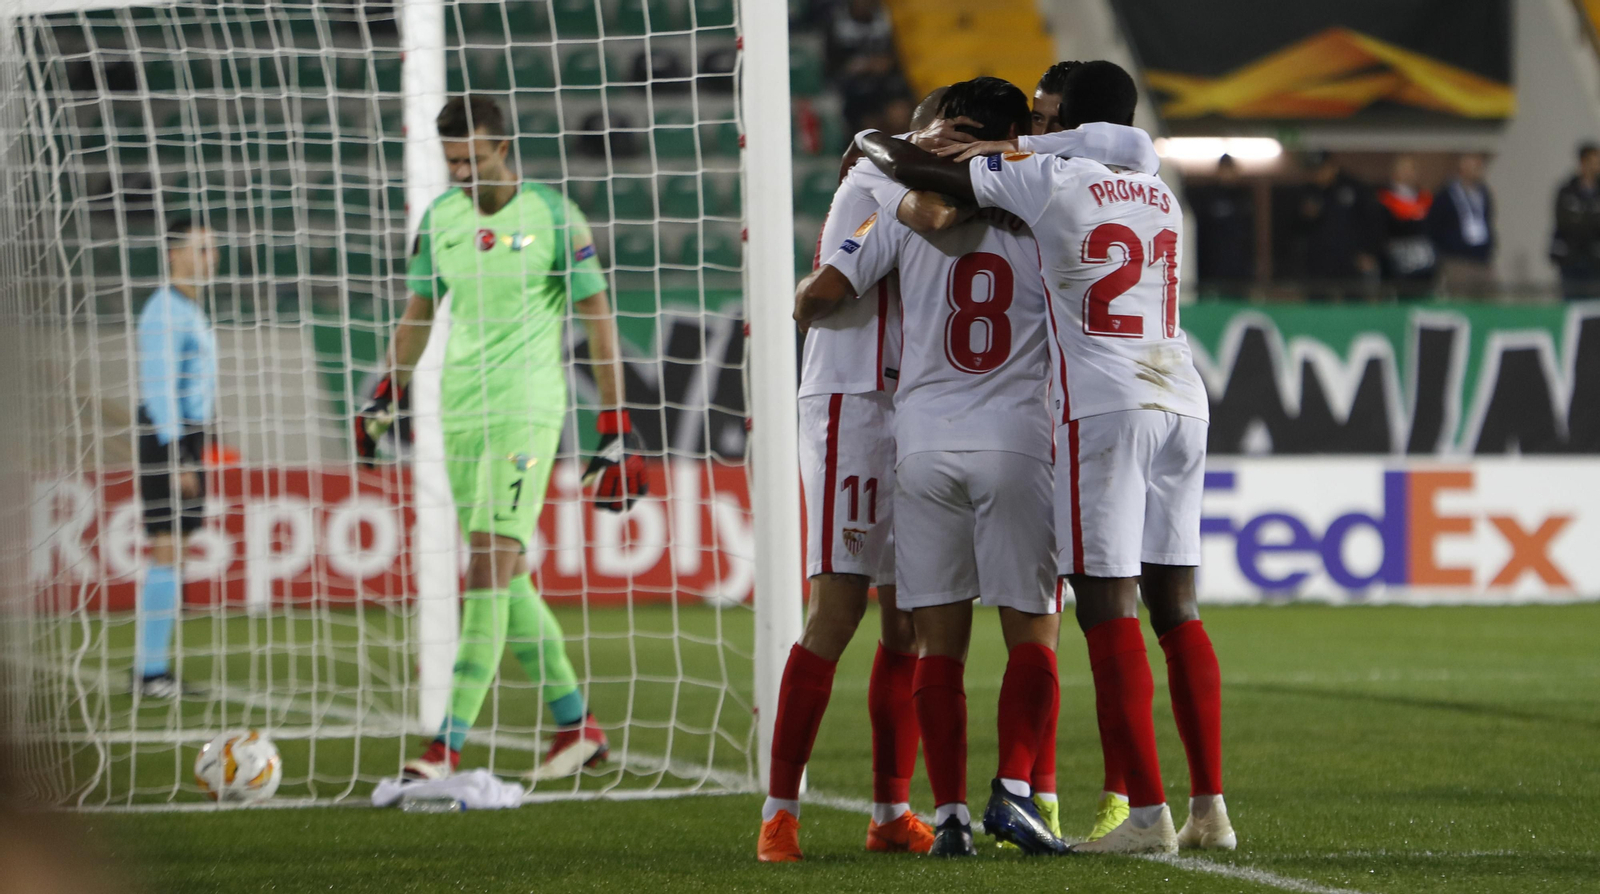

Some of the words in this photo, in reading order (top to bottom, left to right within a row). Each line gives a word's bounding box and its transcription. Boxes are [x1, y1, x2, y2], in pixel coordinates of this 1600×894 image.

[1088, 179, 1171, 214] PROMES
[944, 251, 1014, 375] 8
[1081, 223, 1179, 339] 21
[509, 477, 523, 512] 1
[841, 475, 878, 524] 11
[30, 464, 756, 614] Respoibly
